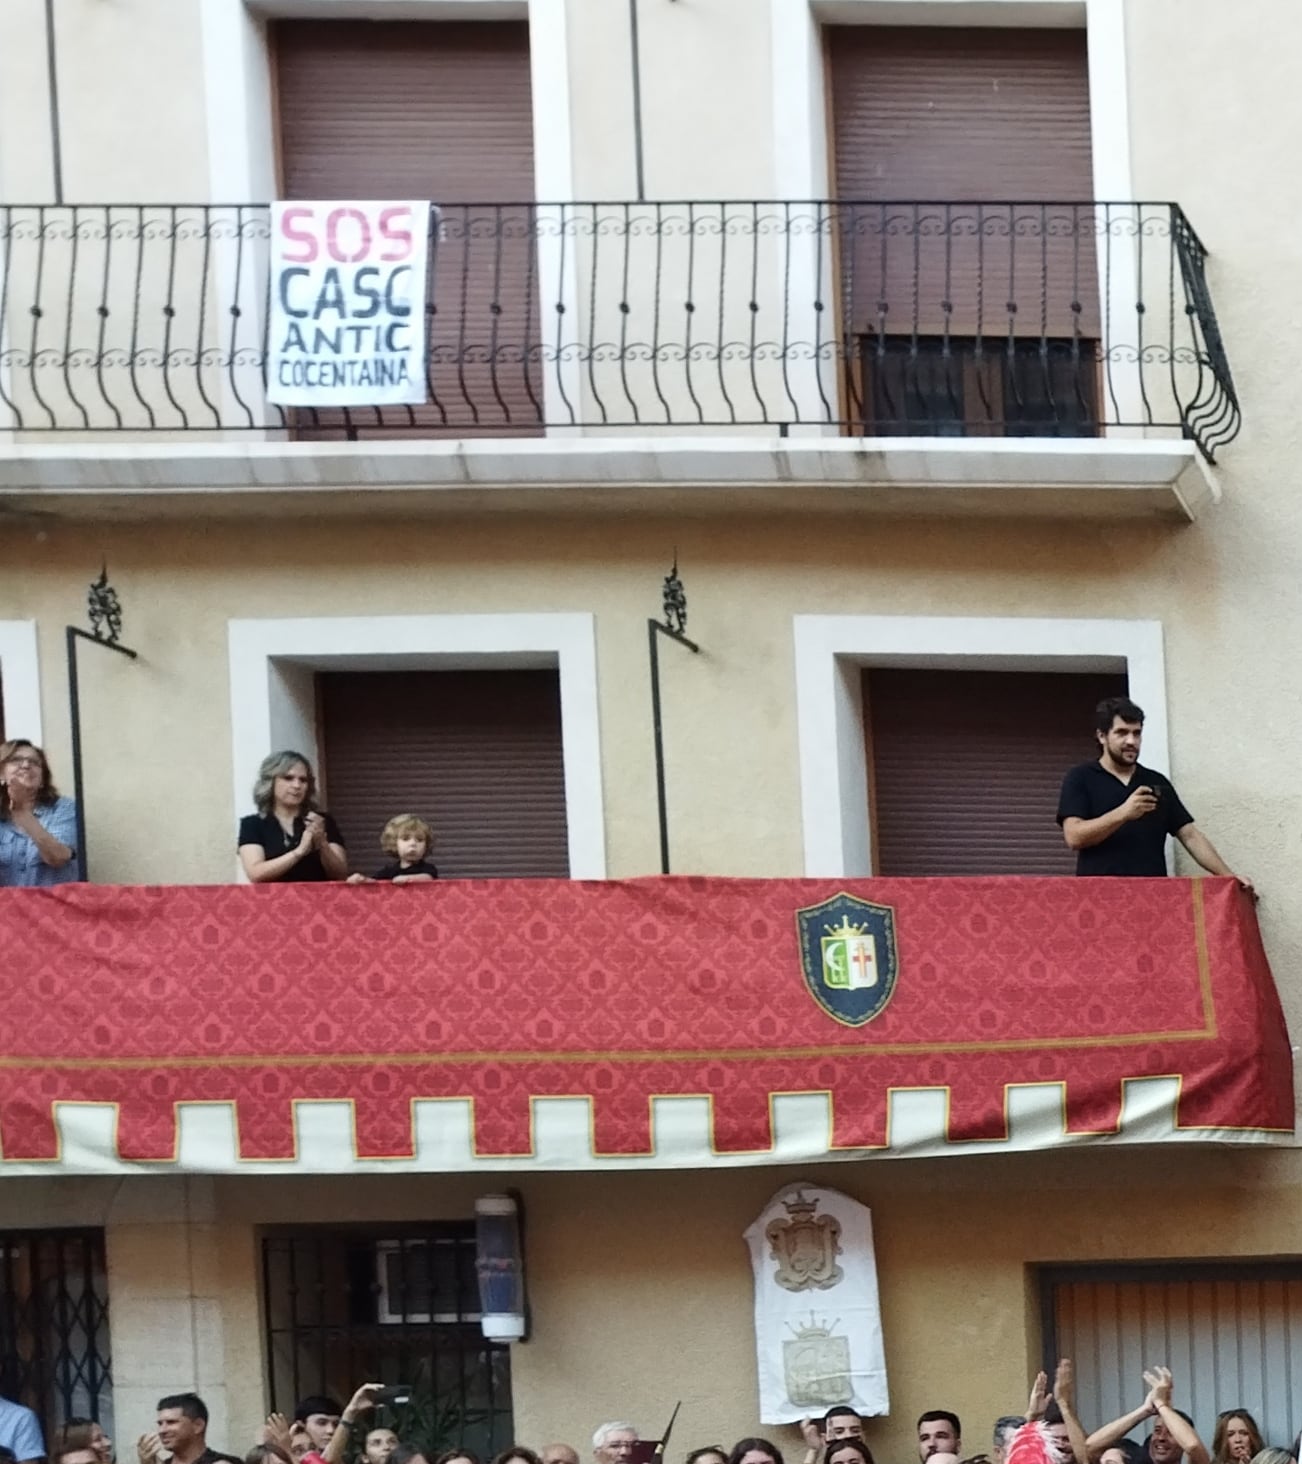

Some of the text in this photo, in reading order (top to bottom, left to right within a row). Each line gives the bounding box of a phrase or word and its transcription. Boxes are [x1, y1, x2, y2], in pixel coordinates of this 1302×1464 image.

[280, 206, 413, 263] SOS
[278, 265, 413, 320] CASC
[280, 322, 411, 354] ANTIC
[278, 358, 412, 388] COCENTAINA
